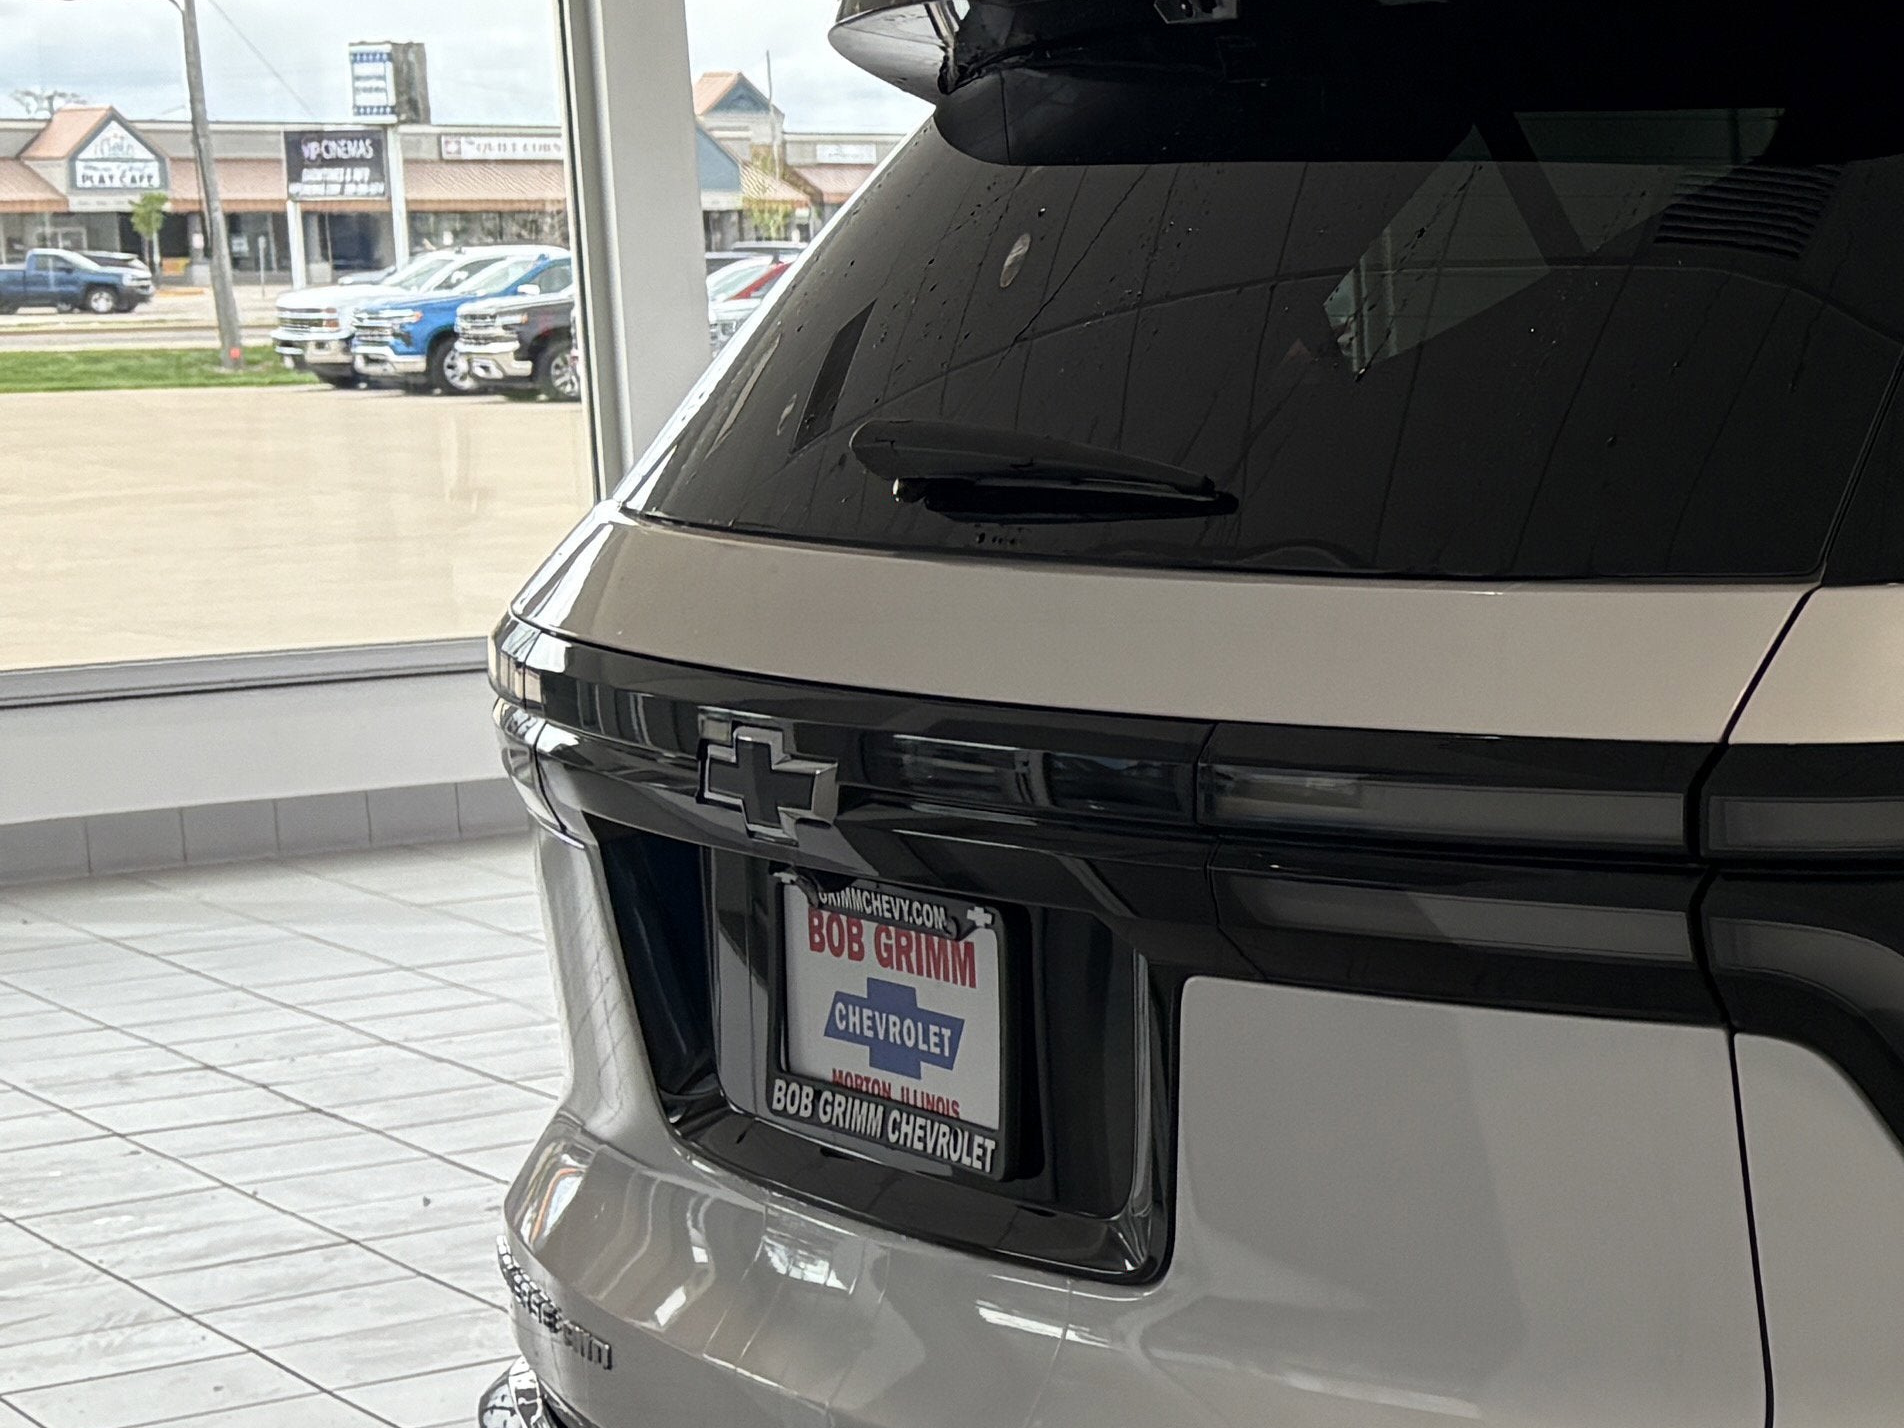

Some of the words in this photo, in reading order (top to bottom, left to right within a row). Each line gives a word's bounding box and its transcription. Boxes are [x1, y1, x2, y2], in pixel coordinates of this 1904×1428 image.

[808, 906, 865, 962] BOB
[874, 922, 977, 989] GRIMM
[834, 1000, 951, 1058] CHEVROLET
[832, 1068, 892, 1100] MORTON
[772, 1078, 815, 1118] BOB
[818, 1090, 884, 1140] GRIMM
[887, 1109, 996, 1173] CHEVROLET
